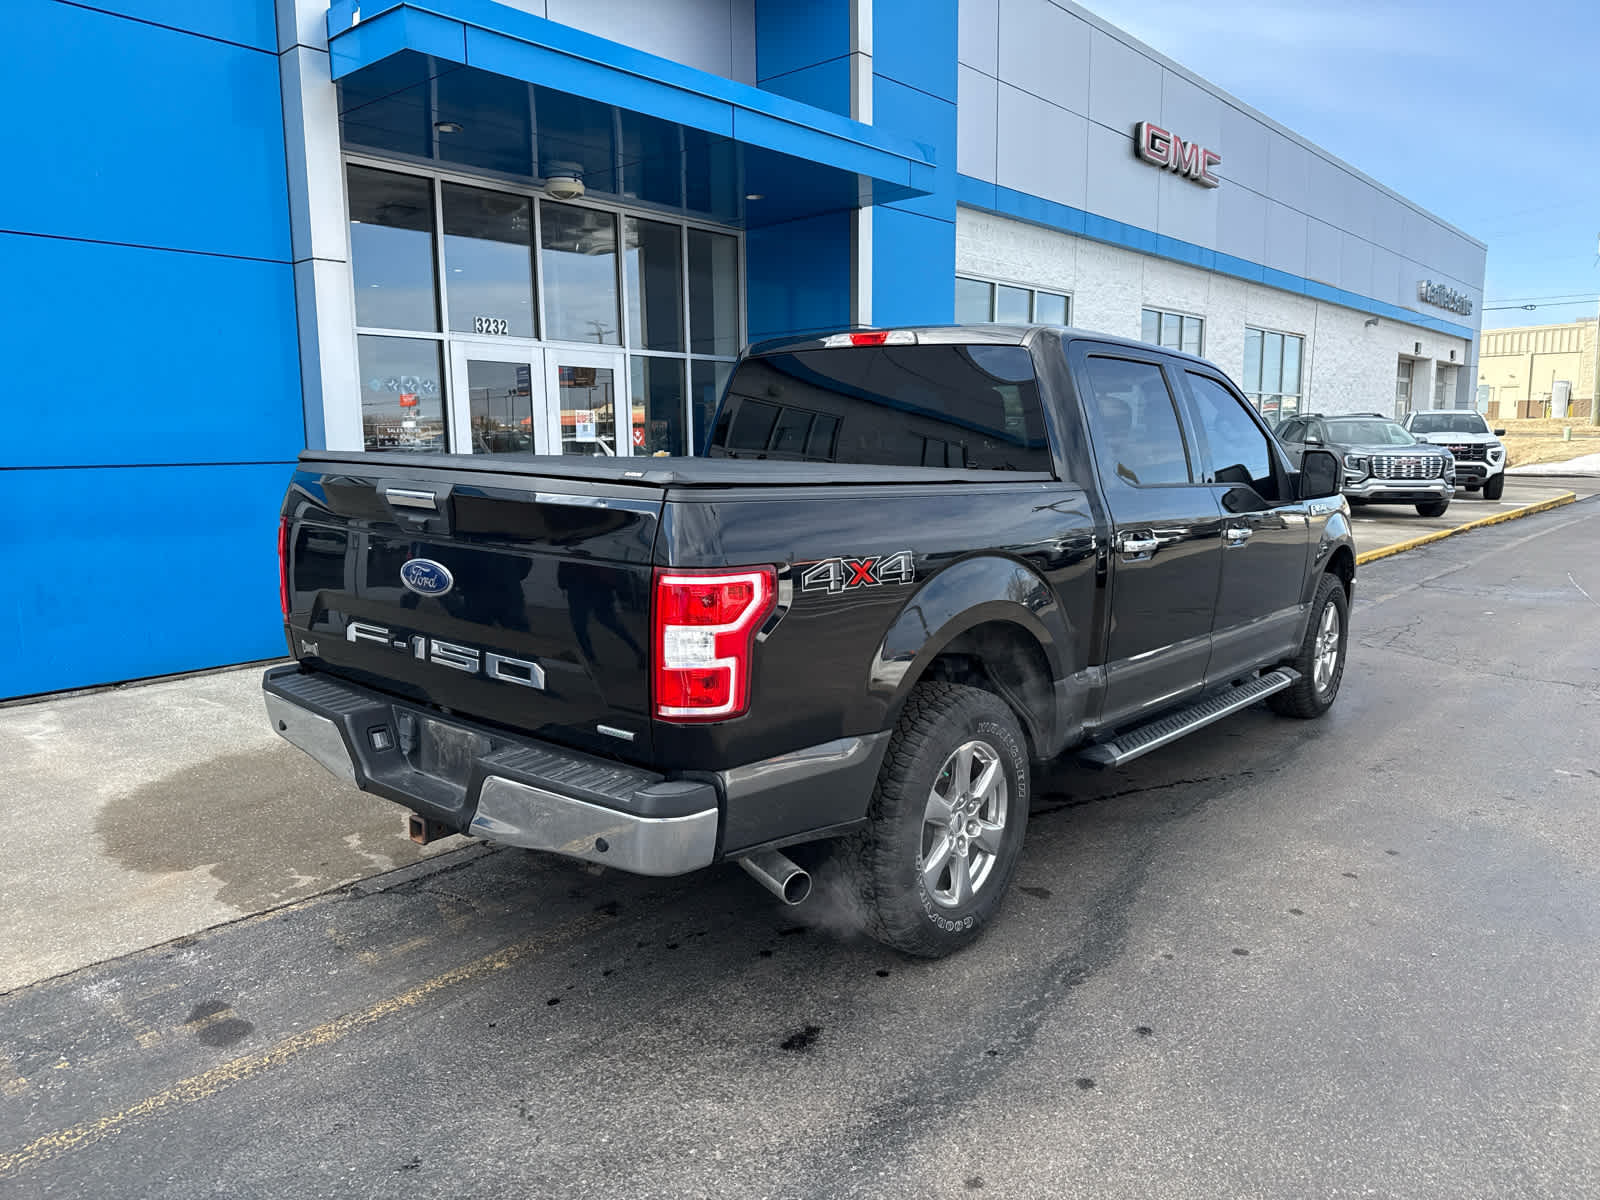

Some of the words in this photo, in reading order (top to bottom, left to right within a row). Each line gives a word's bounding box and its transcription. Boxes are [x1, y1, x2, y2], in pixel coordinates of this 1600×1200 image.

[1134, 120, 1221, 188] GMC
[476, 317, 508, 335] 3232
[409, 565, 438, 589] Ford
[346, 621, 546, 690] F-150
